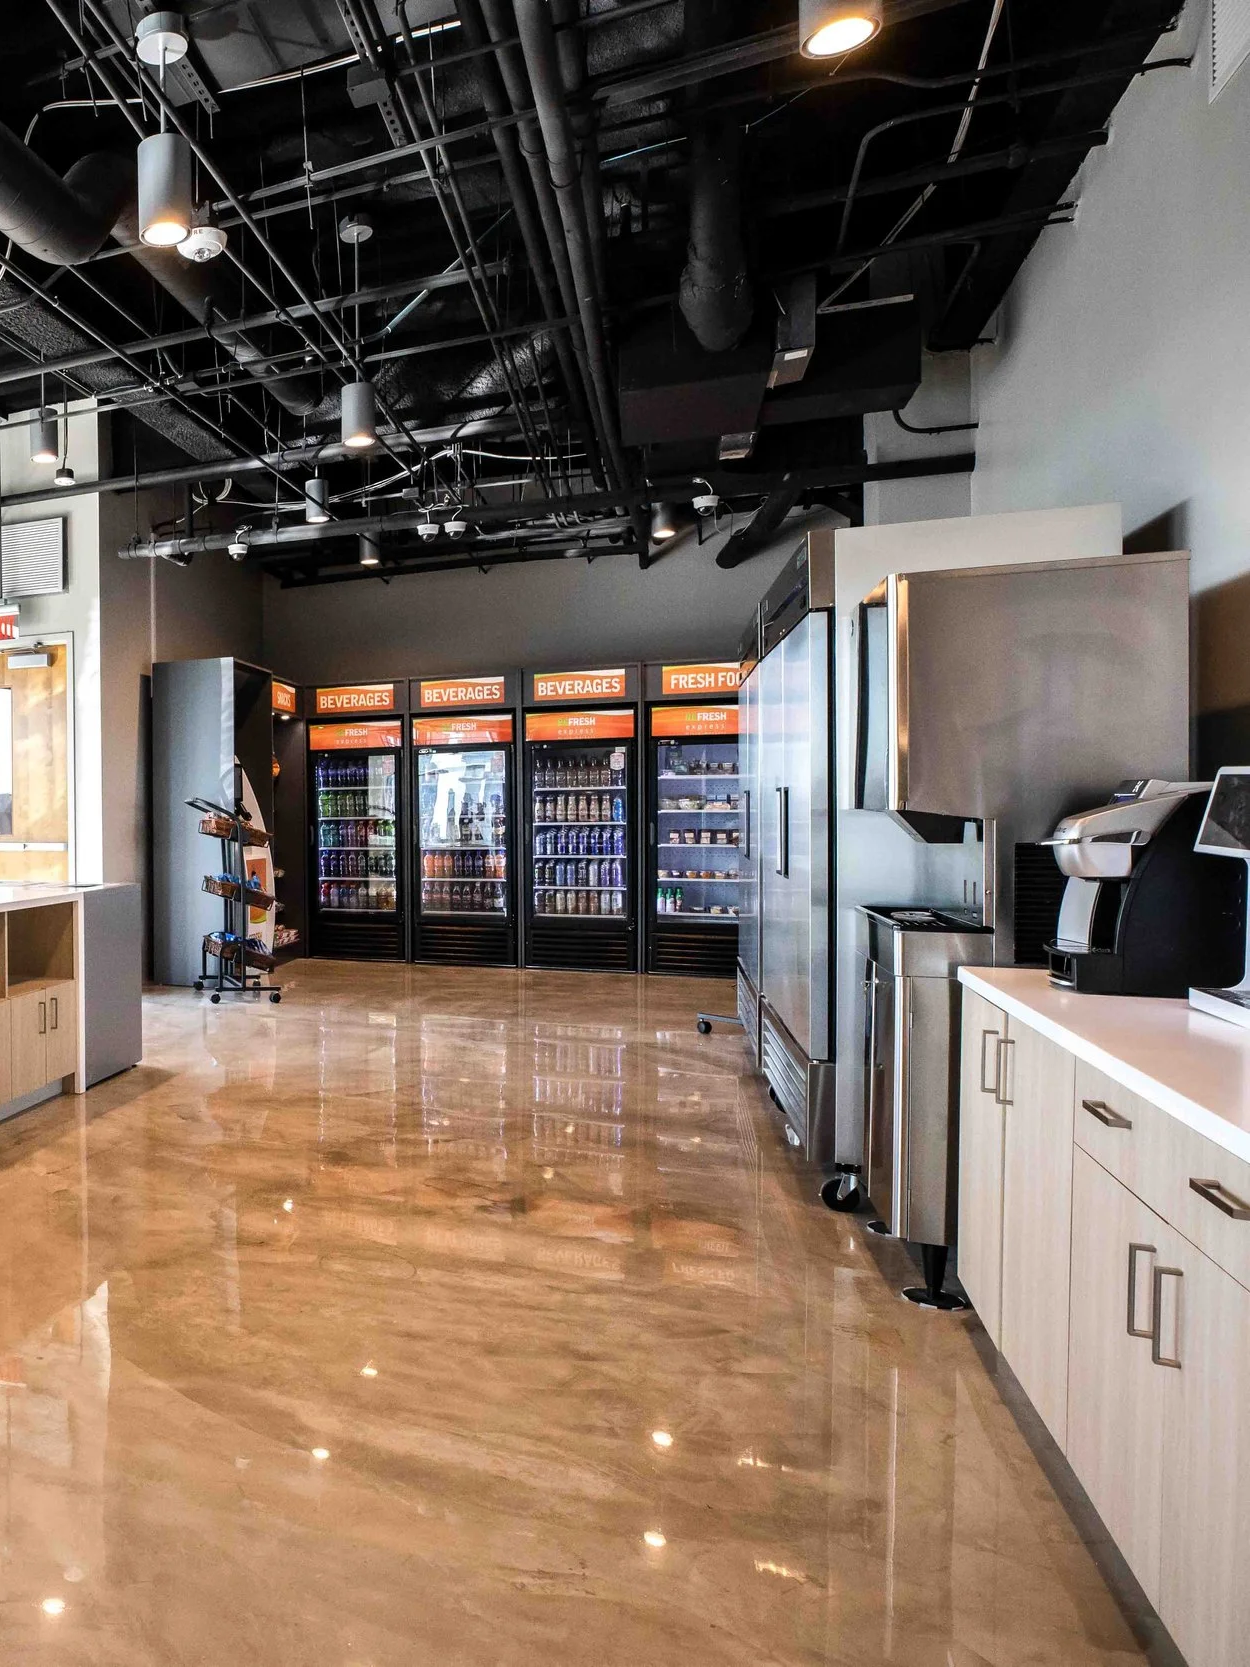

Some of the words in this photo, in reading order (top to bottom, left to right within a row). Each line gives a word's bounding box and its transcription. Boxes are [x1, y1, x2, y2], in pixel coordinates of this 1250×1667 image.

[537, 678, 620, 696] BEVERAGES
[670, 672, 714, 689] FRESH
[319, 692, 390, 708] BEVERAGES
[424, 685, 500, 702] BEVERAGES
